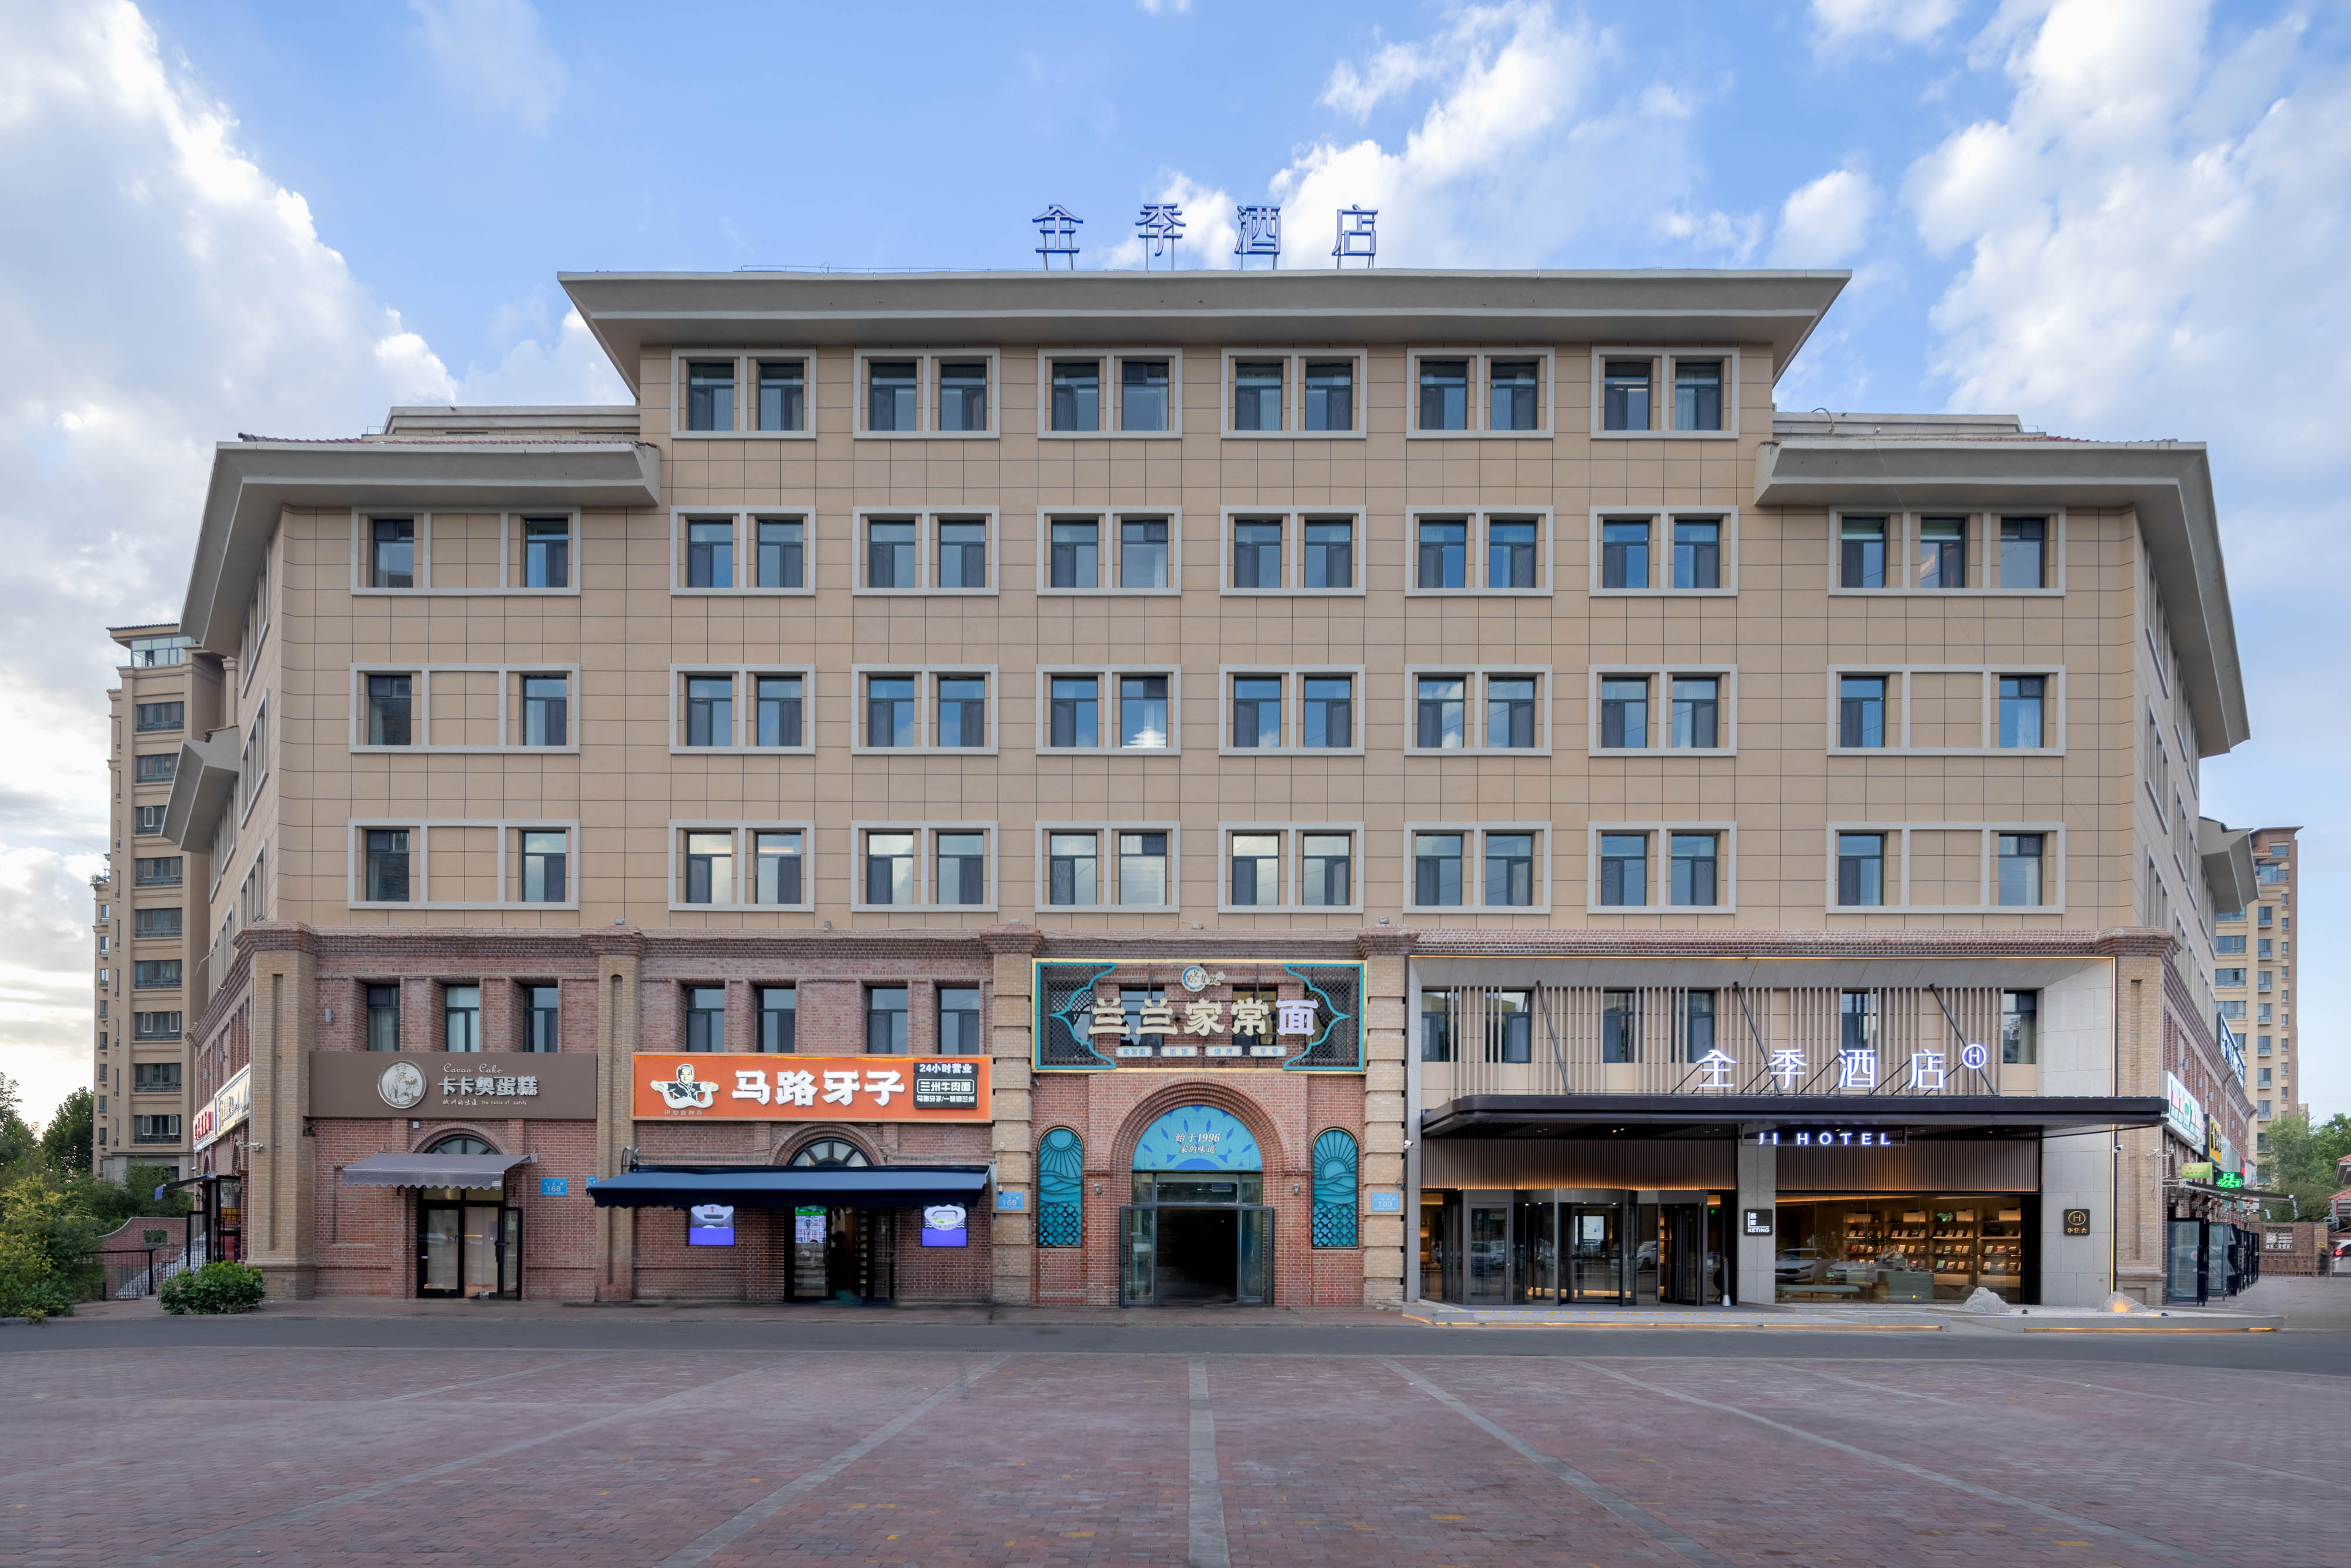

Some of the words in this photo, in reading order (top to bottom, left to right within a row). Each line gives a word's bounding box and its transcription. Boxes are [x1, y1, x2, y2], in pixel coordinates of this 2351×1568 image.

[1032, 203, 1379, 256] 全季酒店
[1088, 997, 1319, 1037] 兰兰家常面
[443, 1063, 473, 1074] Cacao
[479, 1063, 503, 1074] Cake
[919, 1062, 972, 1074] 24小时营业
[1695, 1049, 1946, 1089] 全季酒店
[437, 1076, 539, 1096] 卡卡奥蛋糕
[731, 1069, 905, 1106] 马路牙子
[920, 1082, 971, 1092] 兰州牛肉面
[1175, 1132, 1221, 1143] 始于1996
[1758, 1132, 1778, 1145] JI
[1797, 1132, 1891, 1146] HOTEL
[1179, 1144, 1216, 1154] 家的味道
